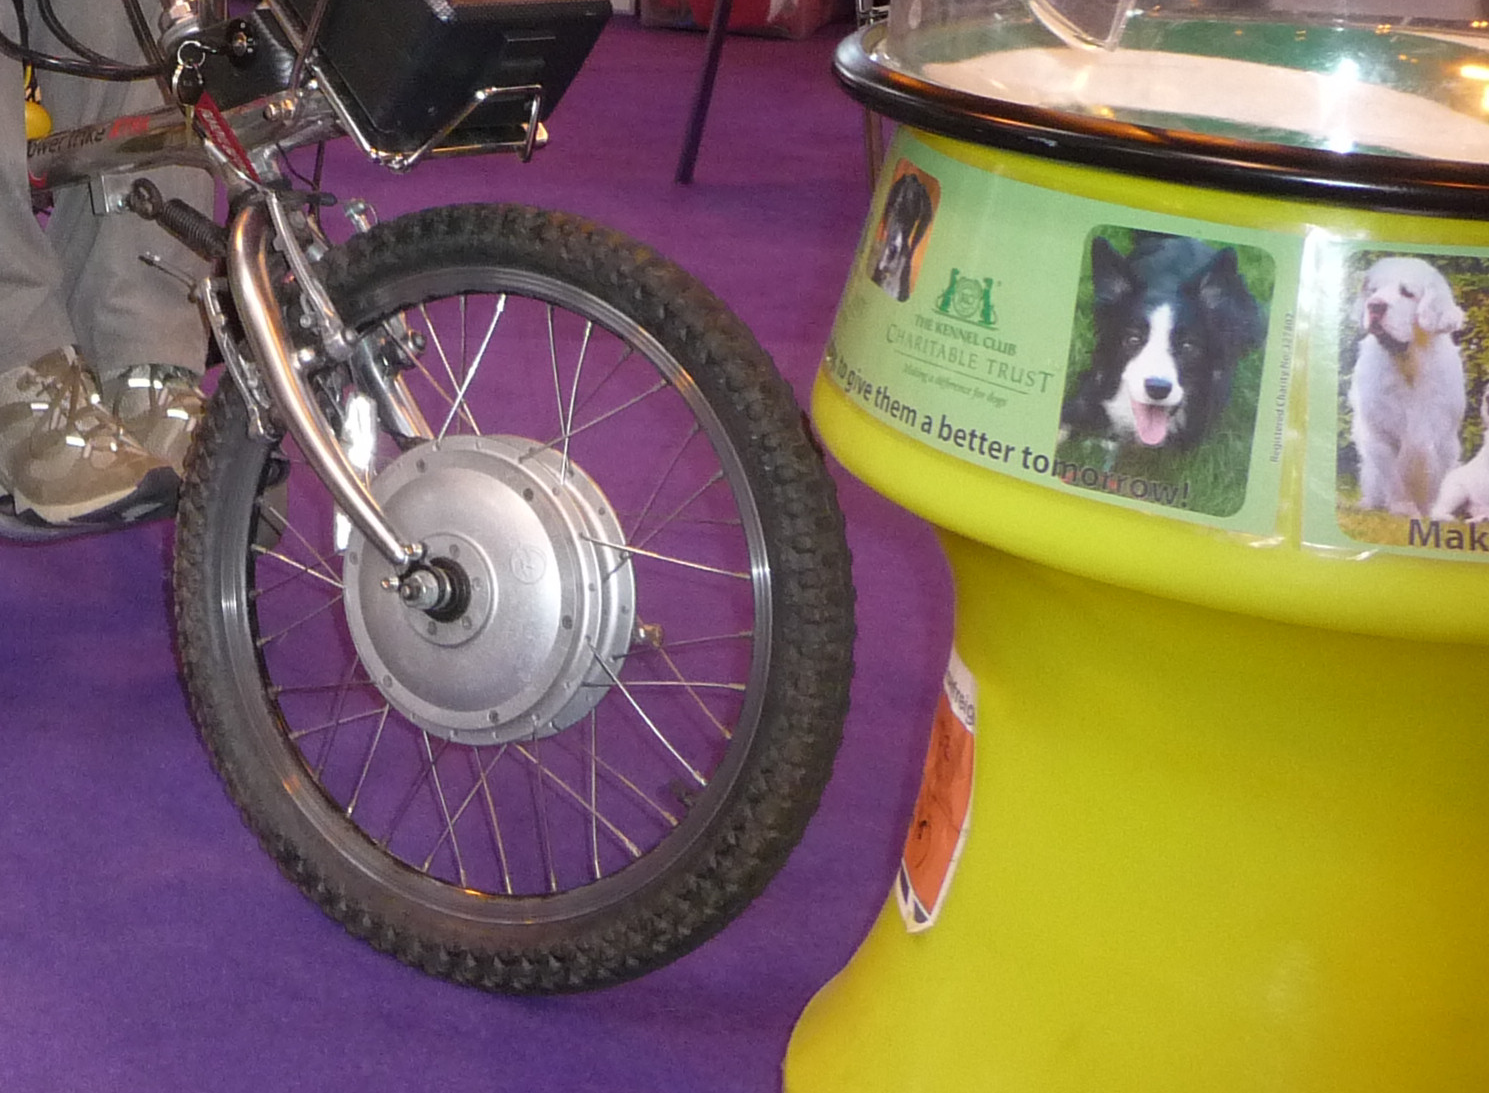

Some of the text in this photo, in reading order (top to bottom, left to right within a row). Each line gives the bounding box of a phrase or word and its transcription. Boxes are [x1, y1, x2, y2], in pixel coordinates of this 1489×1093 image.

[886, 324, 979, 370] CHARITABLE
[987, 358, 1055, 394] TRUST
[915, 314, 1017, 357] THE KENNEL CLUB
[847, 368, 873, 402] give
[874, 386, 918, 428] them
[921, 414, 933, 435] a
[938, 414, 1015, 464] better
[1021, 445, 1190, 508] tomorrow!
